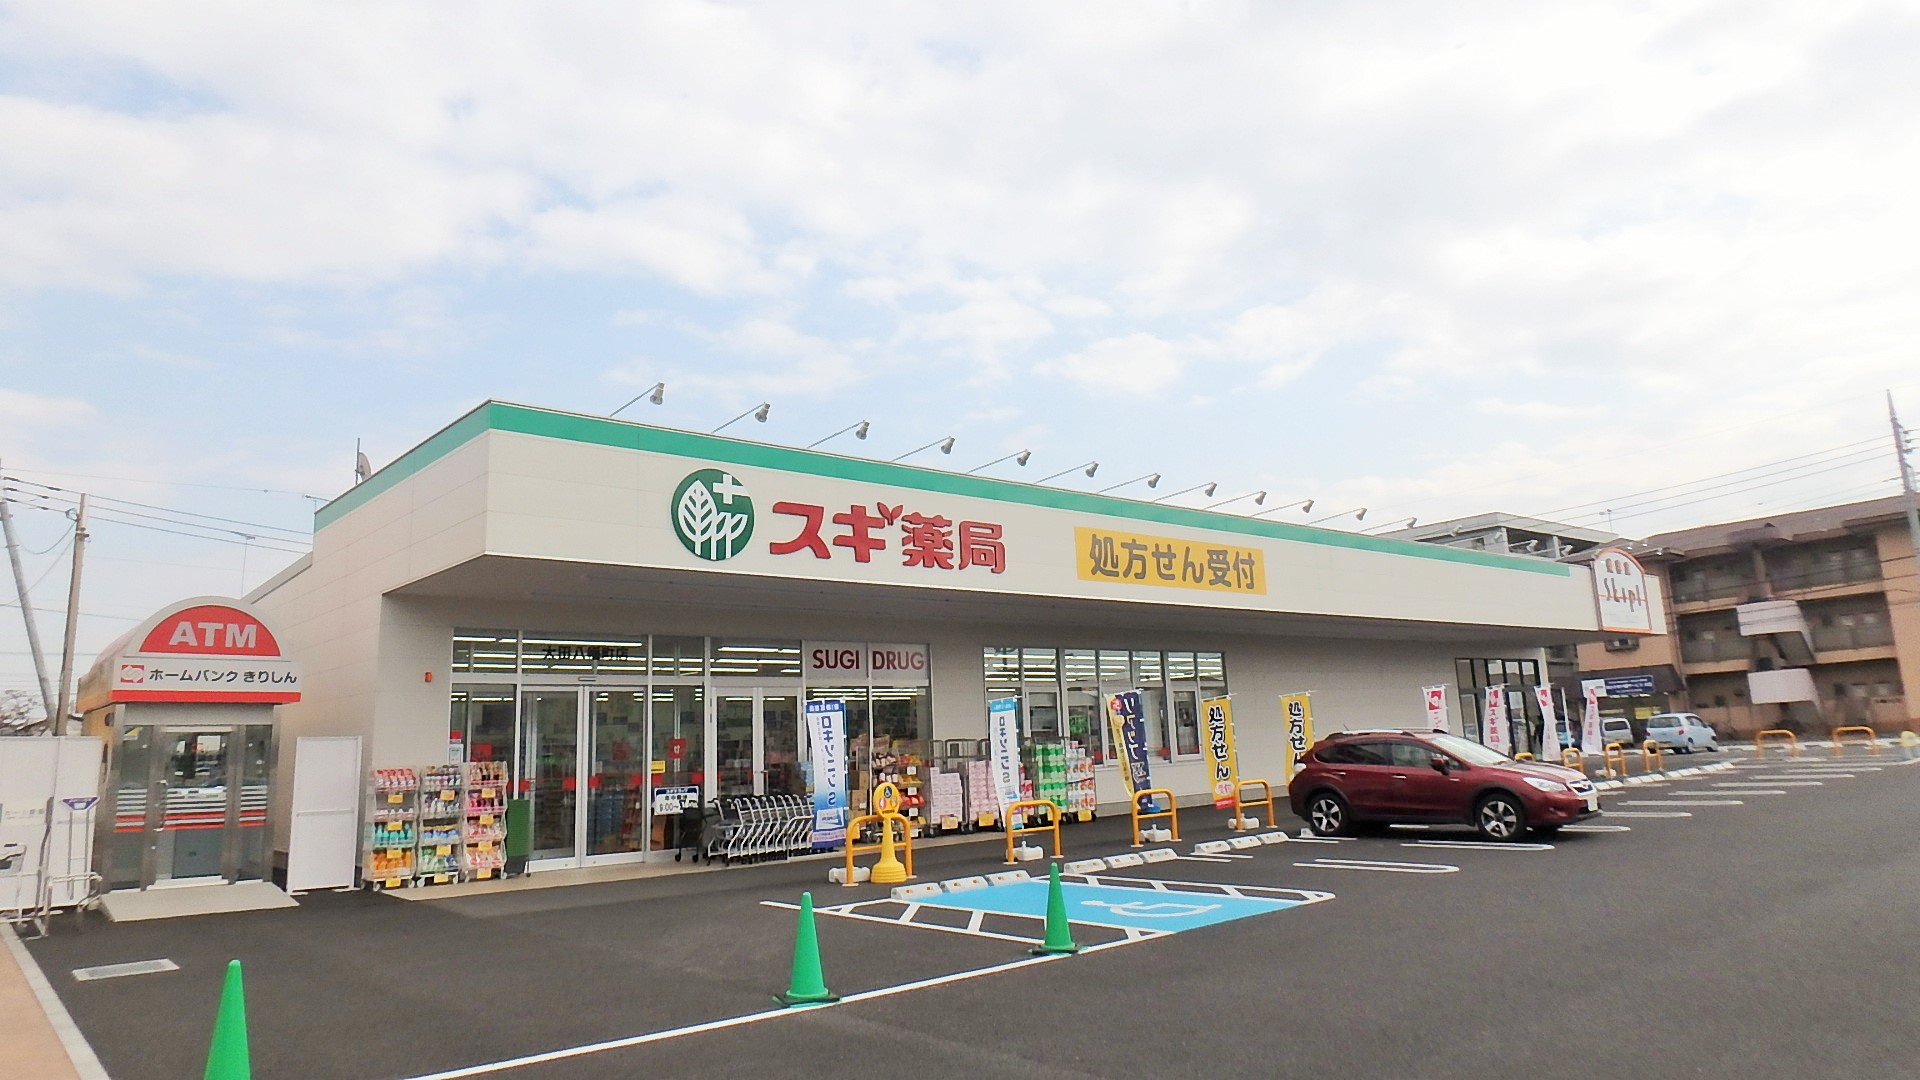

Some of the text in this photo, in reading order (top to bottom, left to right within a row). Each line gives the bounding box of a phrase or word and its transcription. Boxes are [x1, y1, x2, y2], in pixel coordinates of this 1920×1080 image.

[770, 501, 1006, 574] スギ薬局
[1089, 533, 1256, 590] 処方せん受付
[168, 621, 257, 649] ATM
[149, 668, 297, 685] ホームバンク きりしん
[812, 649, 925, 671] SUGI DRUG
[1208, 706, 1230, 780] 処方せん
